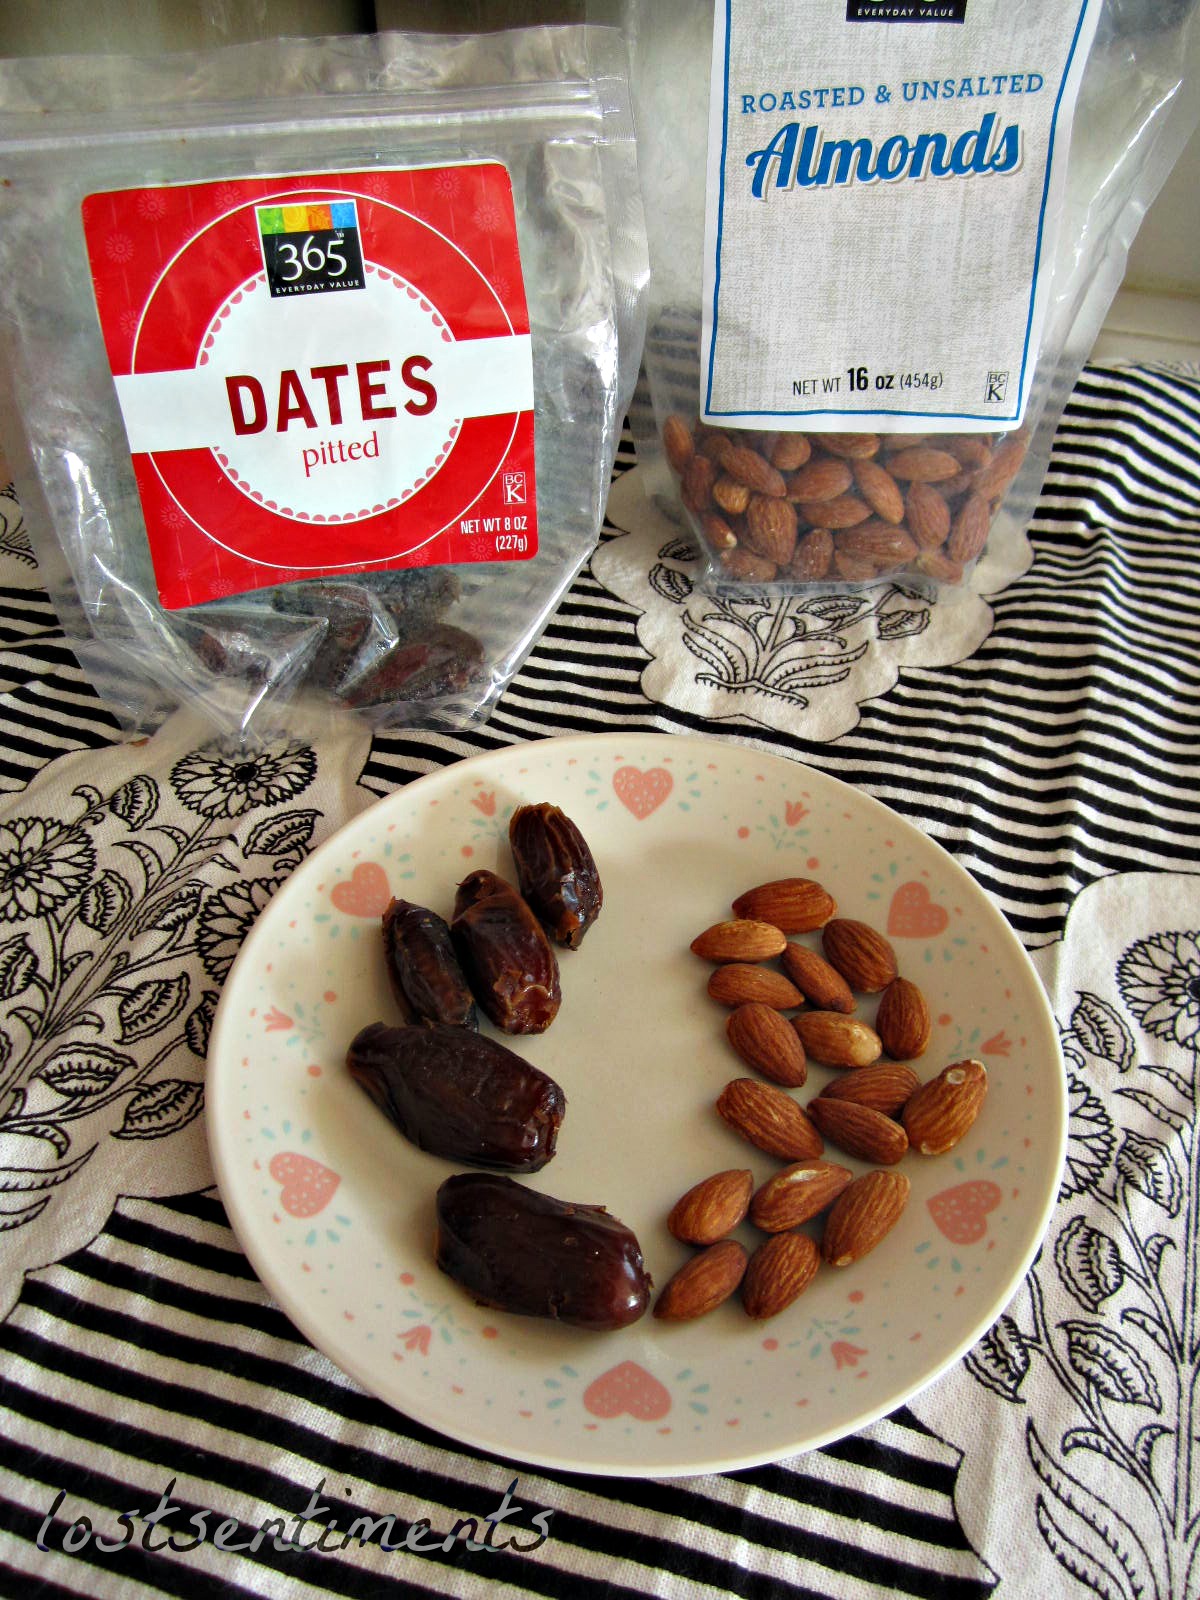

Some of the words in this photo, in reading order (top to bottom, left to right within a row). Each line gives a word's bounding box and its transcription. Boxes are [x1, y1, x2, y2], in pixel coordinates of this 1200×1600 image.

[857, 8, 914, 17] EVERYDAY
[920, 8, 954, 17] VALUE
[741, 86, 865, 114] ROASTED
[874, 85, 892, 103] &
[902, 73, 1044, 101] UNSALTED
[745, 112, 1022, 200] Almonds
[278, 235, 348, 281] 365
[275, 283, 325, 294] EVERYDAY
[329, 280, 360, 288] VALUE
[792, 379, 818, 396] NET
[822, 377, 842, 393] WT
[847, 367, 868, 391] 16
[875, 375, 895, 390] oz
[900, 372, 944, 390] (454g)
[225, 355, 438, 436] DATES
[987, 383, 1003, 401] K
[303, 431, 380, 477] pitted
[505, 473, 523, 484] BC
[506, 484, 525, 503] K
[460, 519, 480, 534] NET
[482, 518, 501, 532] WT
[504, 517, 511, 531] 8
[514, 516, 528, 530] OZ
[495, 534, 528, 552] (227g)
